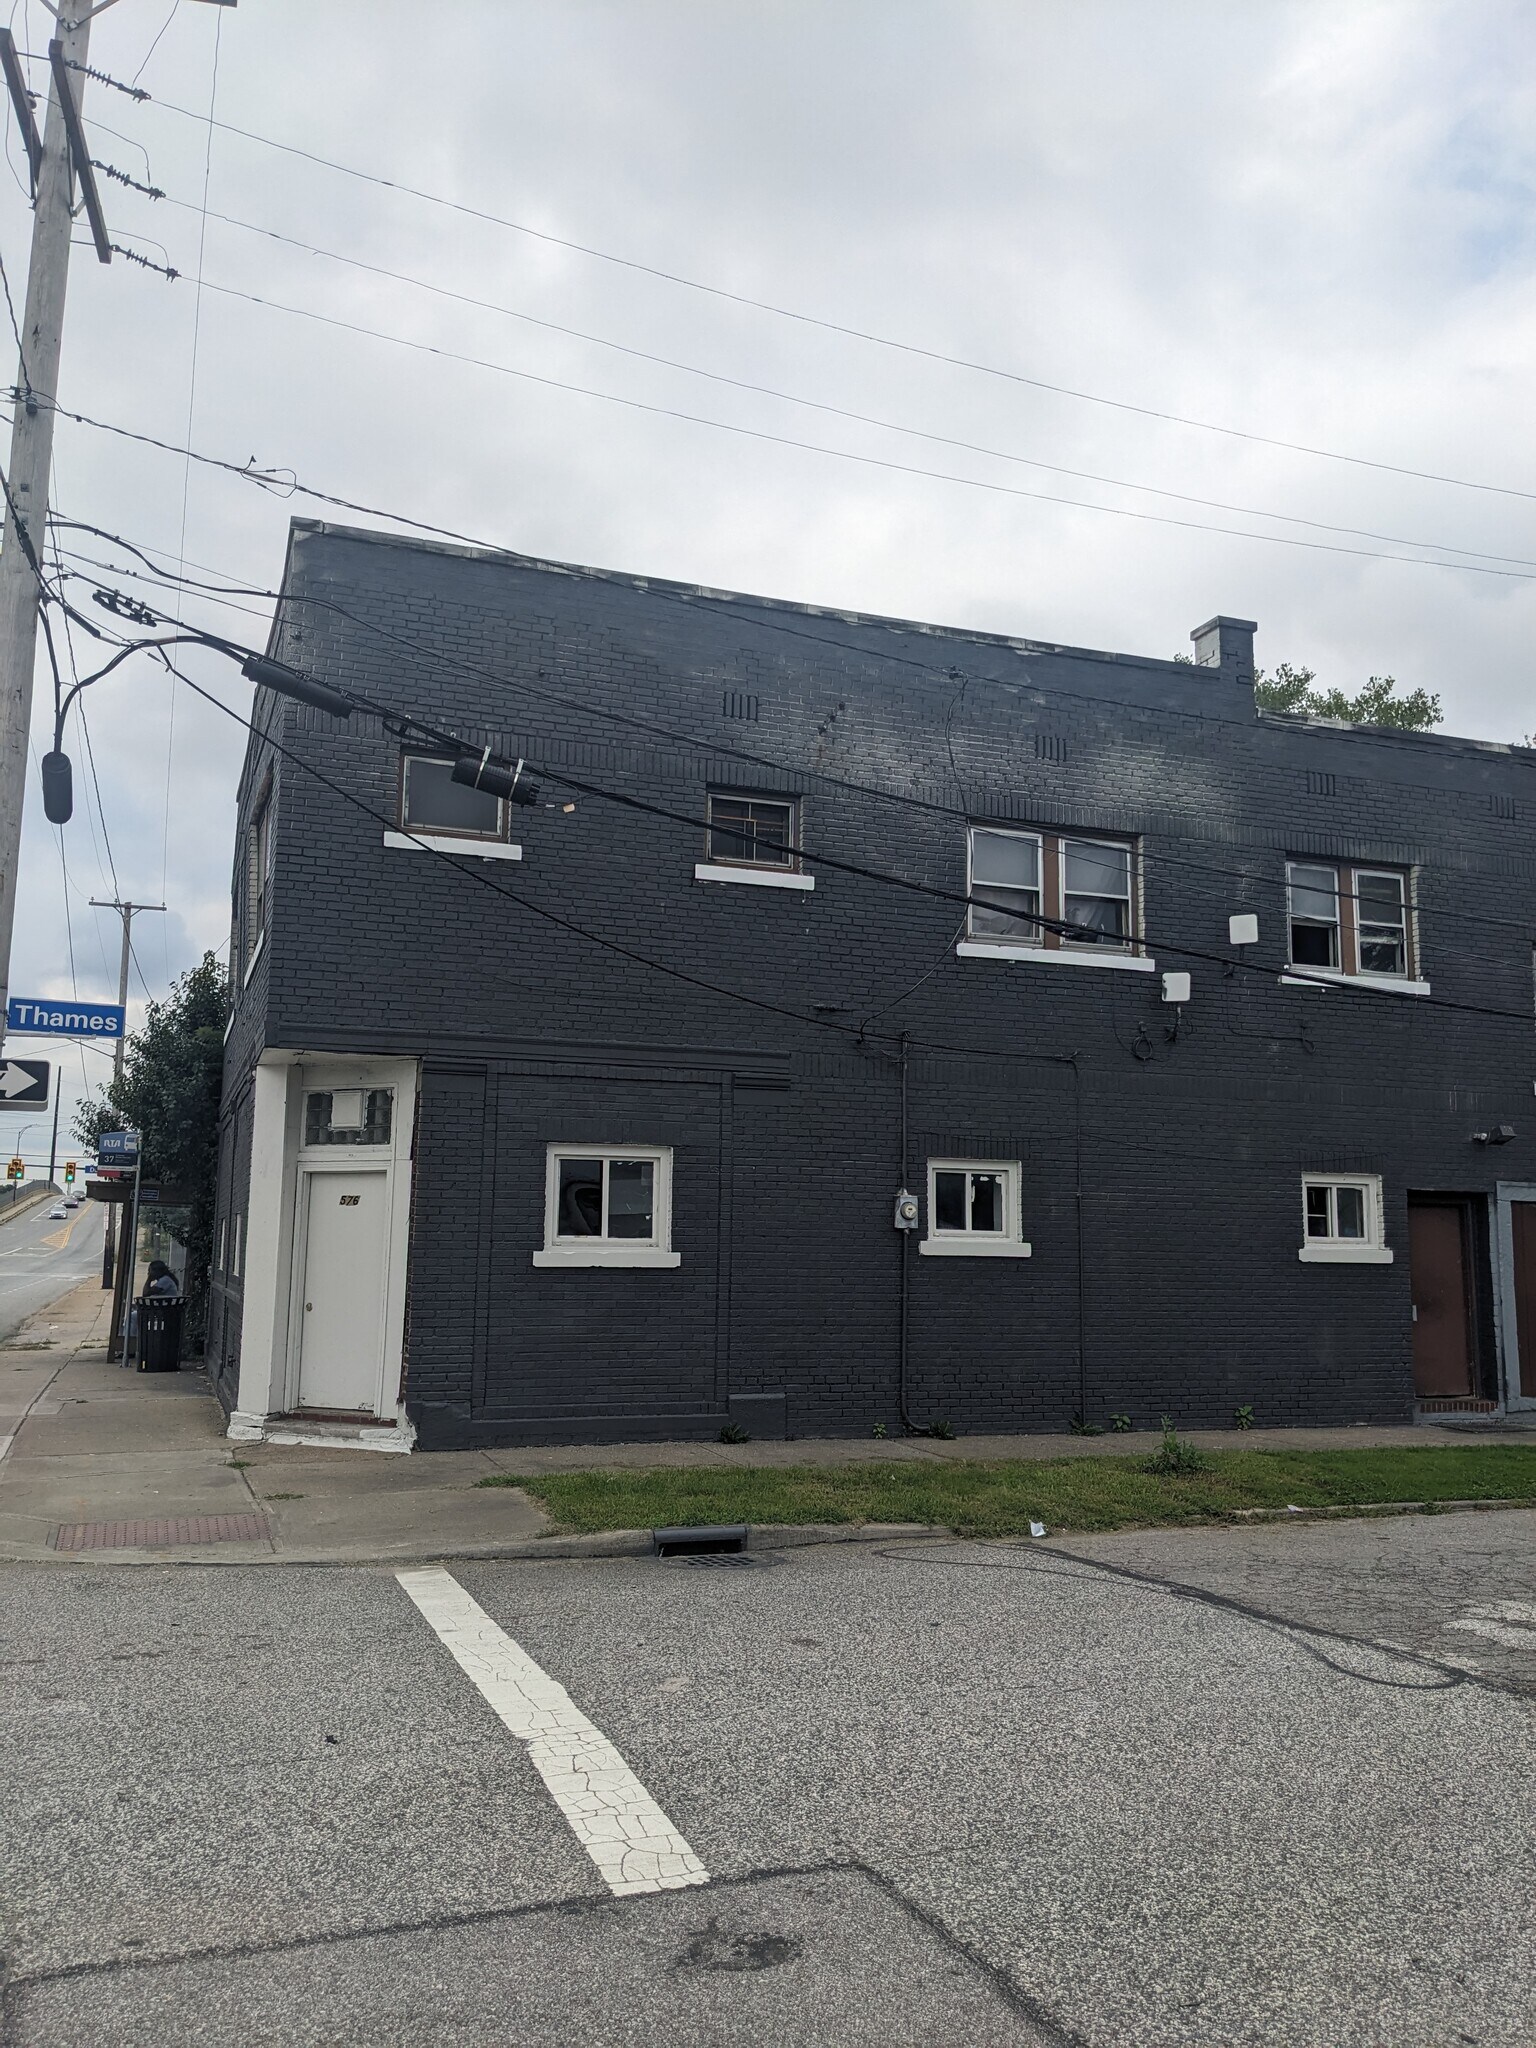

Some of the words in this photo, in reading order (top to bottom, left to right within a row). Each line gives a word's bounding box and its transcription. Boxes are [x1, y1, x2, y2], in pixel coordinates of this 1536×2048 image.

[15, 1004, 118, 1031] Thames
[103, 1139, 121, 1148] RTA
[104, 1155, 114, 1163] 37
[339, 1195, 361, 1206] 576
